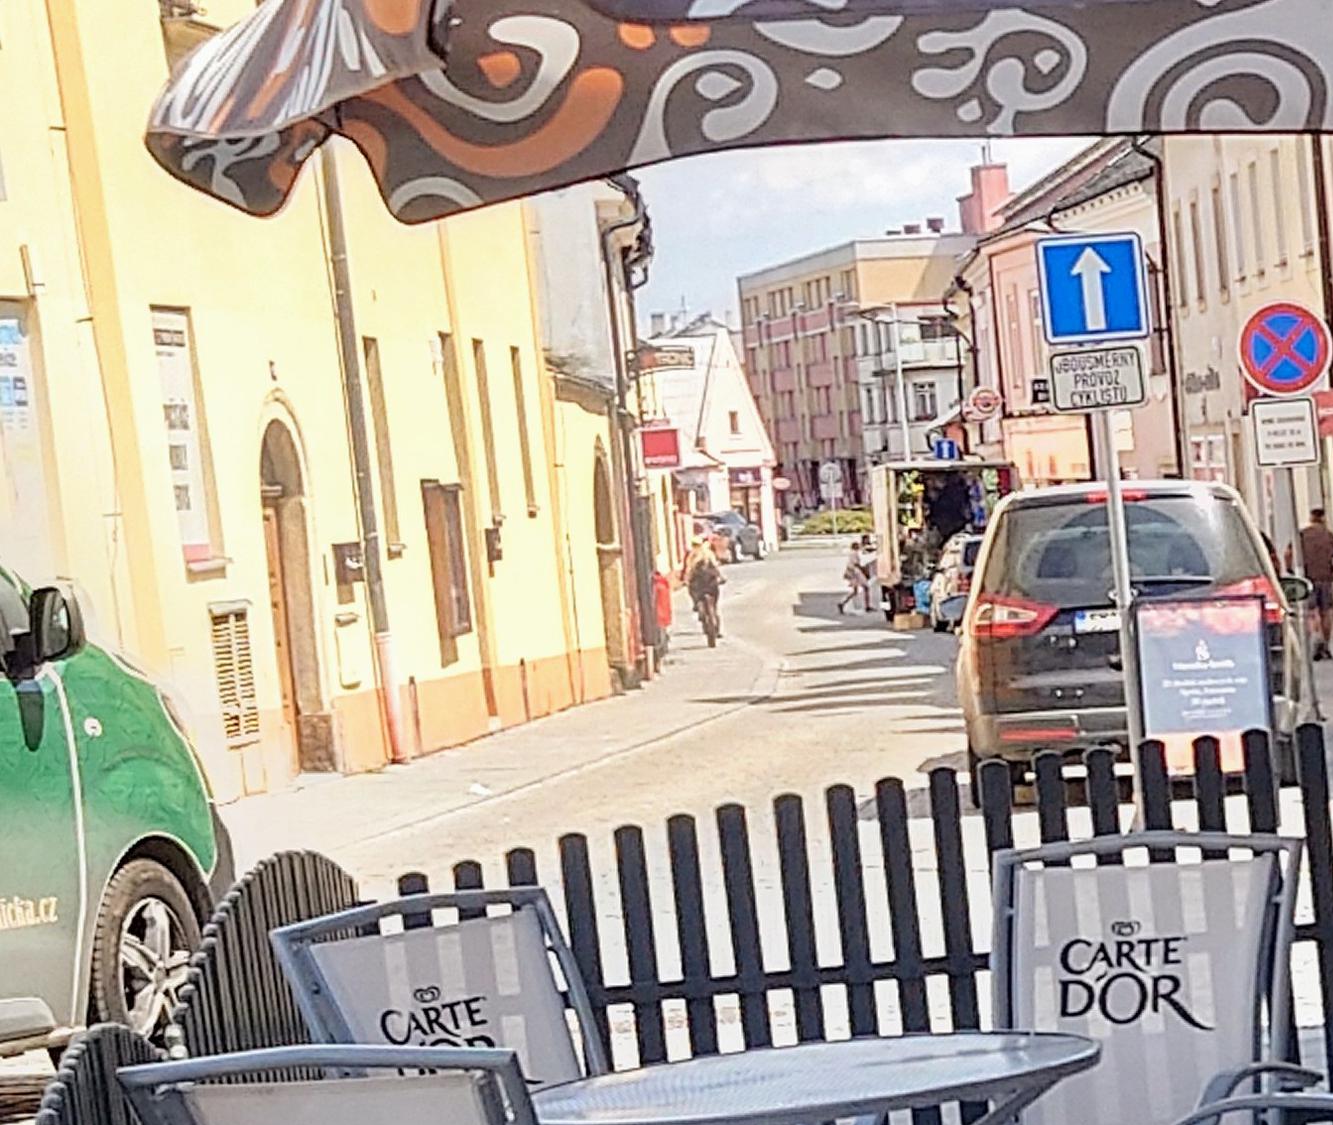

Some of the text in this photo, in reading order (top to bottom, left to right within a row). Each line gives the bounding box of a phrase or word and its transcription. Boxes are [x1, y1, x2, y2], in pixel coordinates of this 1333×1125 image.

[1074, 370, 1121, 389] PROVOZ
[1060, 937, 1183, 975] CARTE
[380, 996, 489, 1045] CARTE
[1058, 970, 1215, 1031] D'OR
